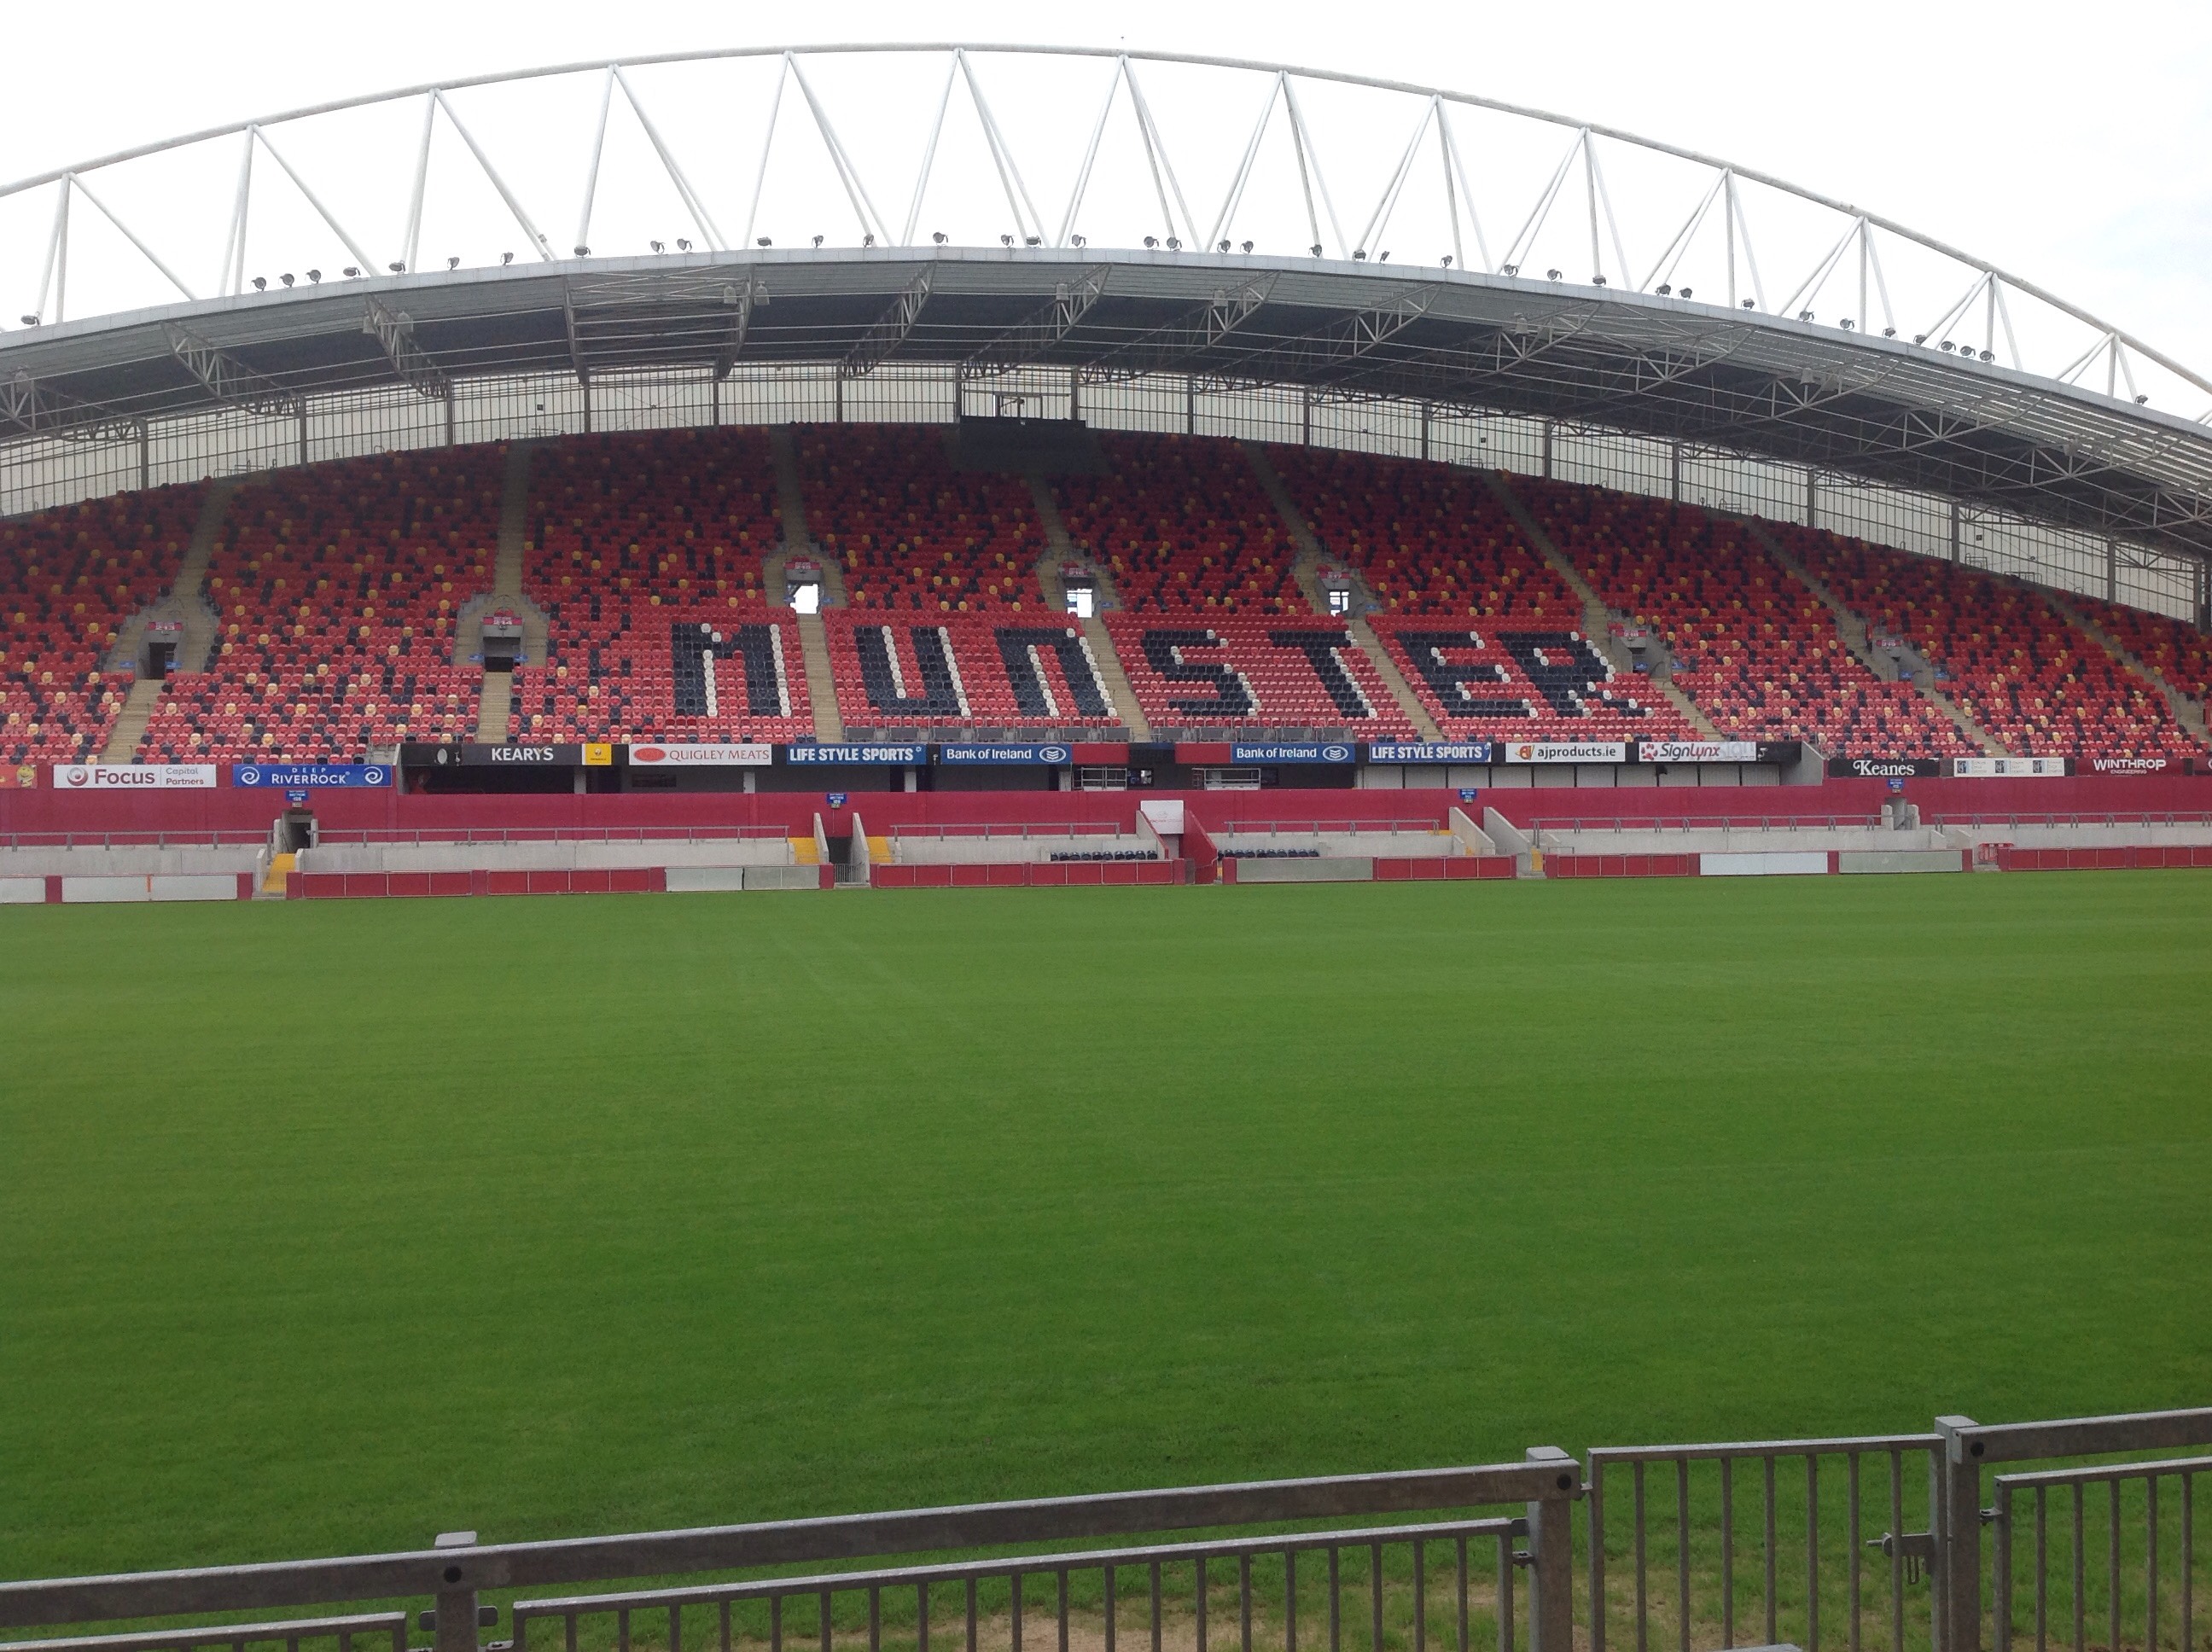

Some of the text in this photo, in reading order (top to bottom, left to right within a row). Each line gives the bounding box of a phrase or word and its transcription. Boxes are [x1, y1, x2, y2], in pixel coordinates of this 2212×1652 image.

[672, 622, 1654, 718] MUNSTER
[491, 747, 554, 761] KEARYS
[669, 749, 770, 761] QUIGLEY MEATS
[789, 747, 914, 761] LIFE STYLE SPORTS
[946, 748, 1032, 759] Bank of Ireland
[1237, 747, 1317, 759] Bank of Ireland
[1371, 746, 1482, 759] LIFE STYLE SPORTS
[1537, 746, 1616, 759] ajproducts.ie
[1659, 742, 1720, 760] SignLynx
[166, 767, 199, 776] Capital
[1853, 759, 1915, 776] Keanes
[2093, 759, 2167, 771] WINTHROP
[95, 769, 155, 785] Focus
